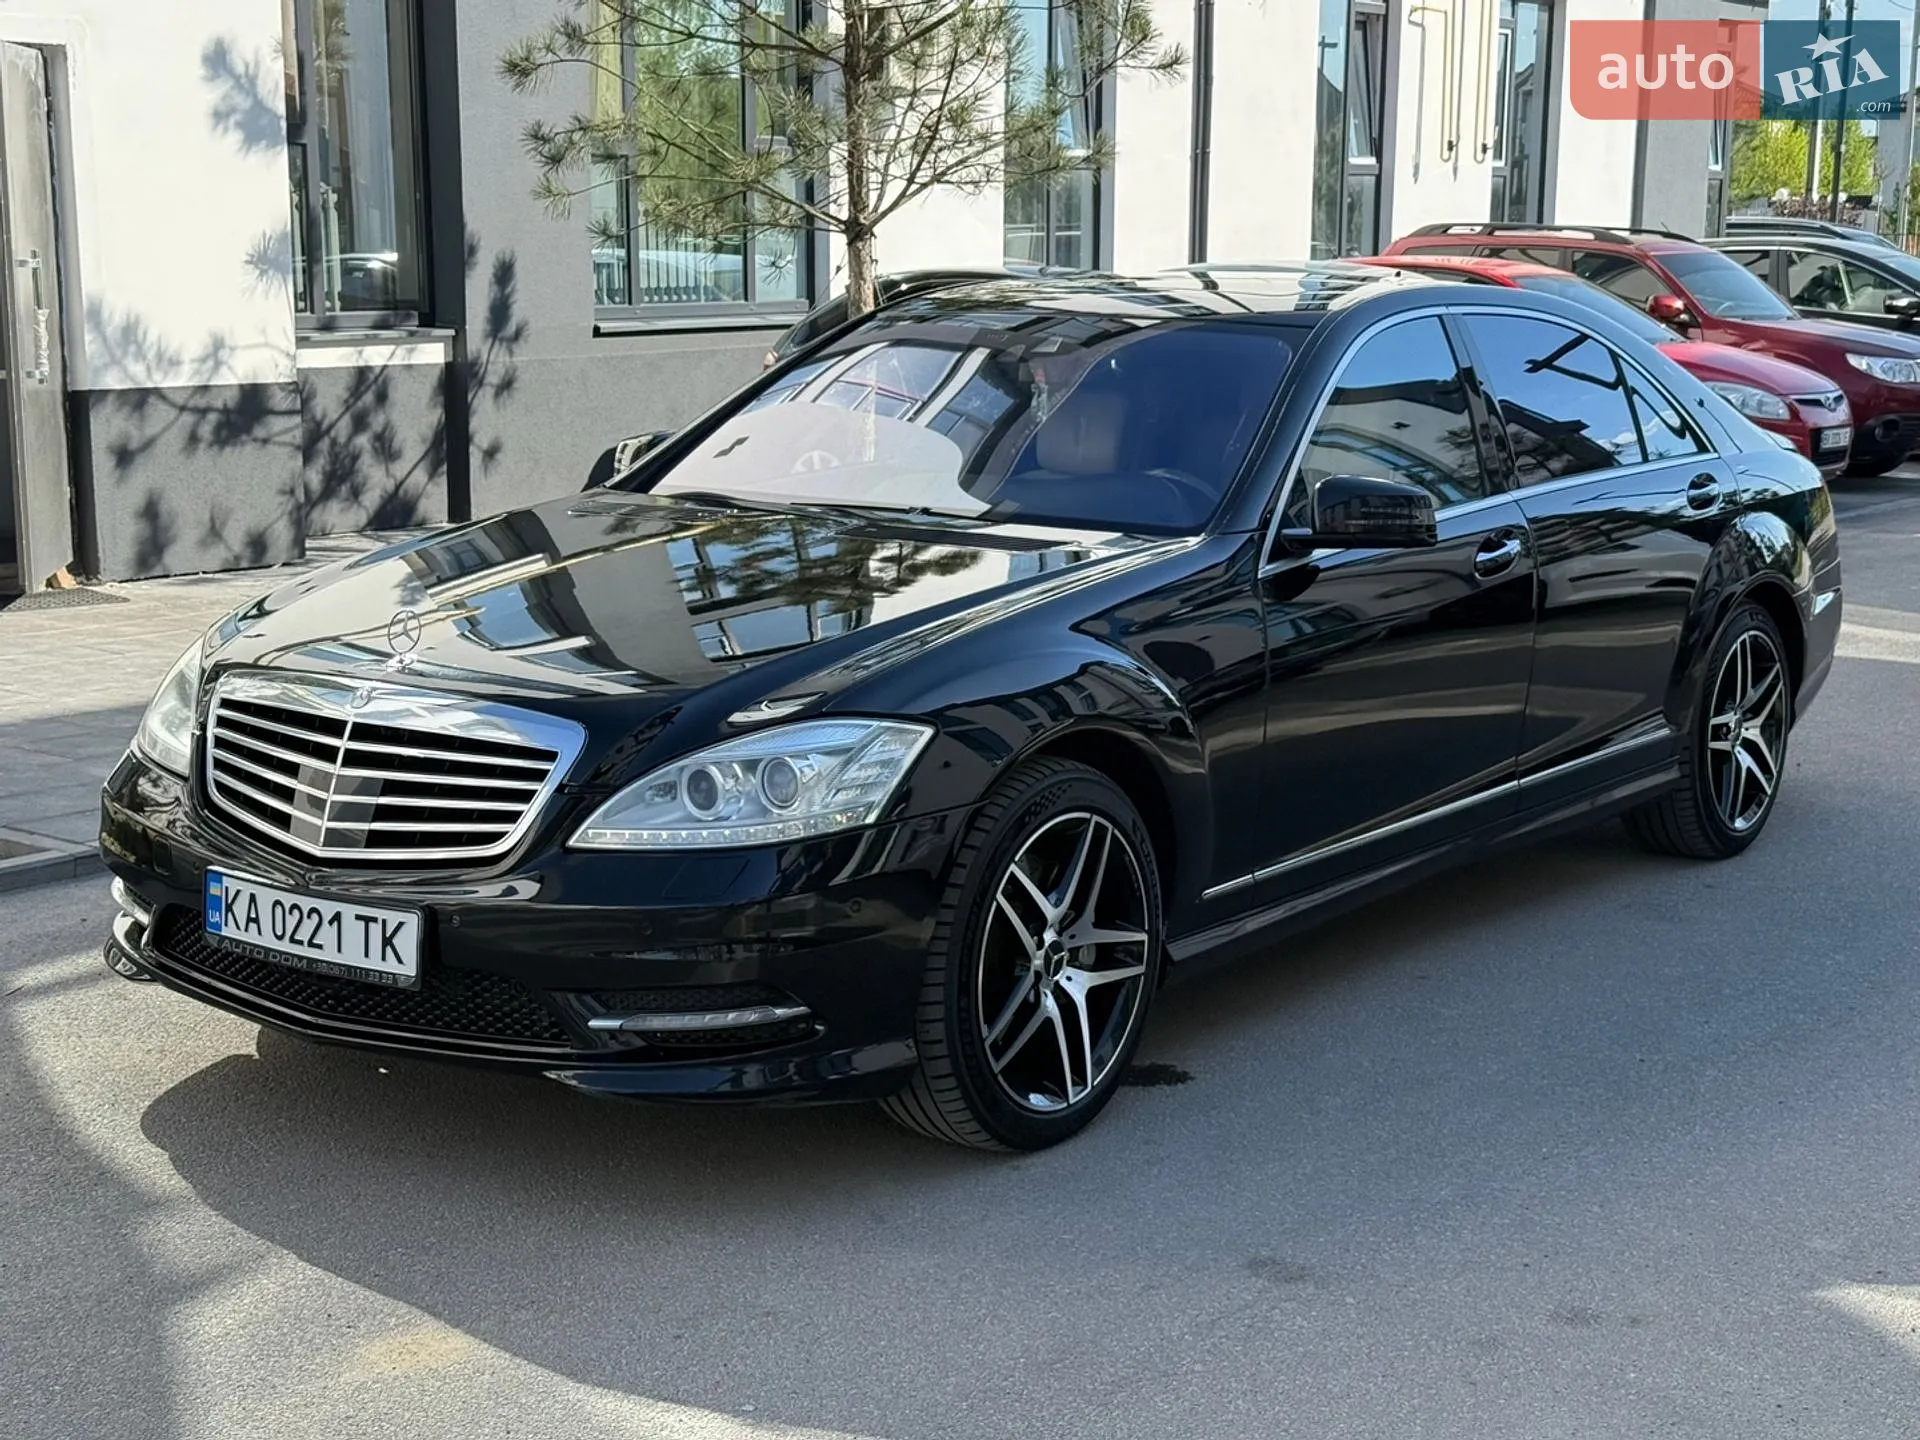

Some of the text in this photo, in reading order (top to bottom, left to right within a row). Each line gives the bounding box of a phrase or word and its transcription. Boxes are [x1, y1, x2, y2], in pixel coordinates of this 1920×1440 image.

[209, 909, 221, 924] UA
[224, 886, 407, 966] KA 0221 TK
[220, 939, 265, 957] AUTO
[269, 951, 307, 967] DOM
